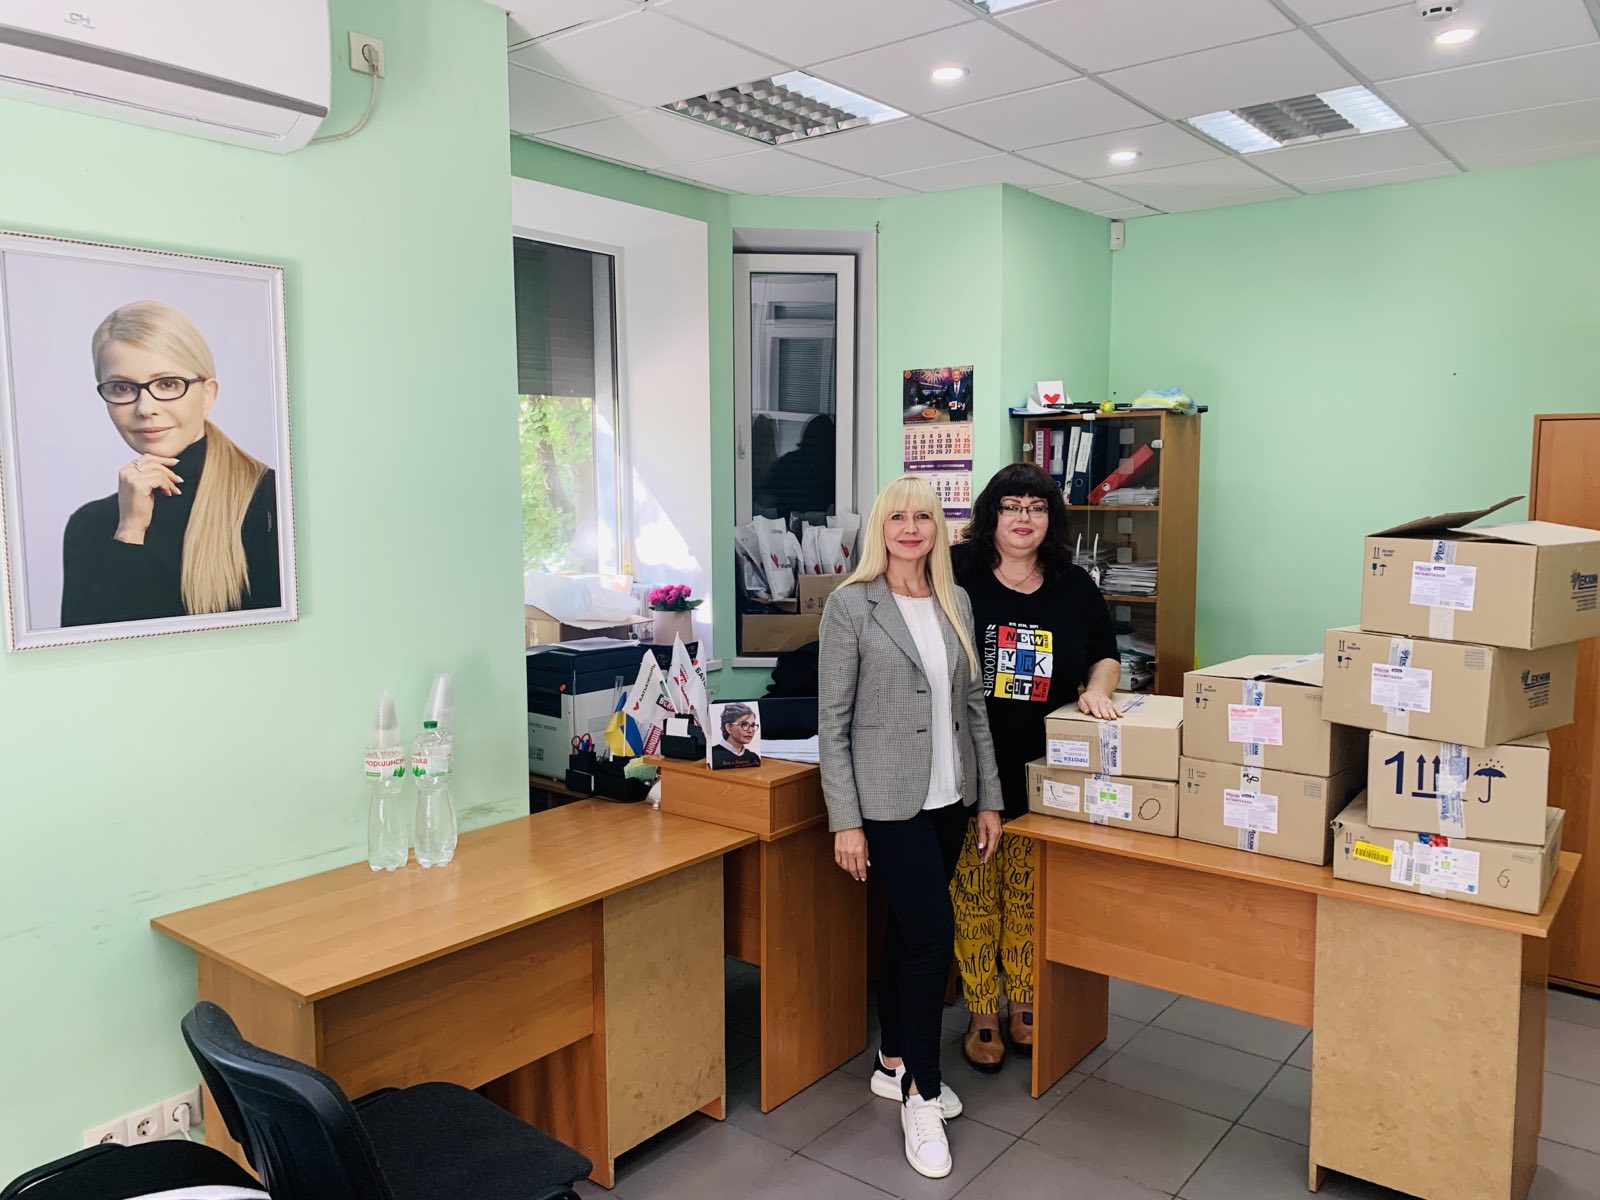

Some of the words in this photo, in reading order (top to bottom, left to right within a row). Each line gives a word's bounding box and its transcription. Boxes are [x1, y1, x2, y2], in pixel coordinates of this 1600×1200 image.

[984, 630, 997, 689] BROOKLYN
[1006, 680, 1041, 695] CITY
[1384, 751, 1404, 794] 1
[1497, 869, 1510, 888] 6
